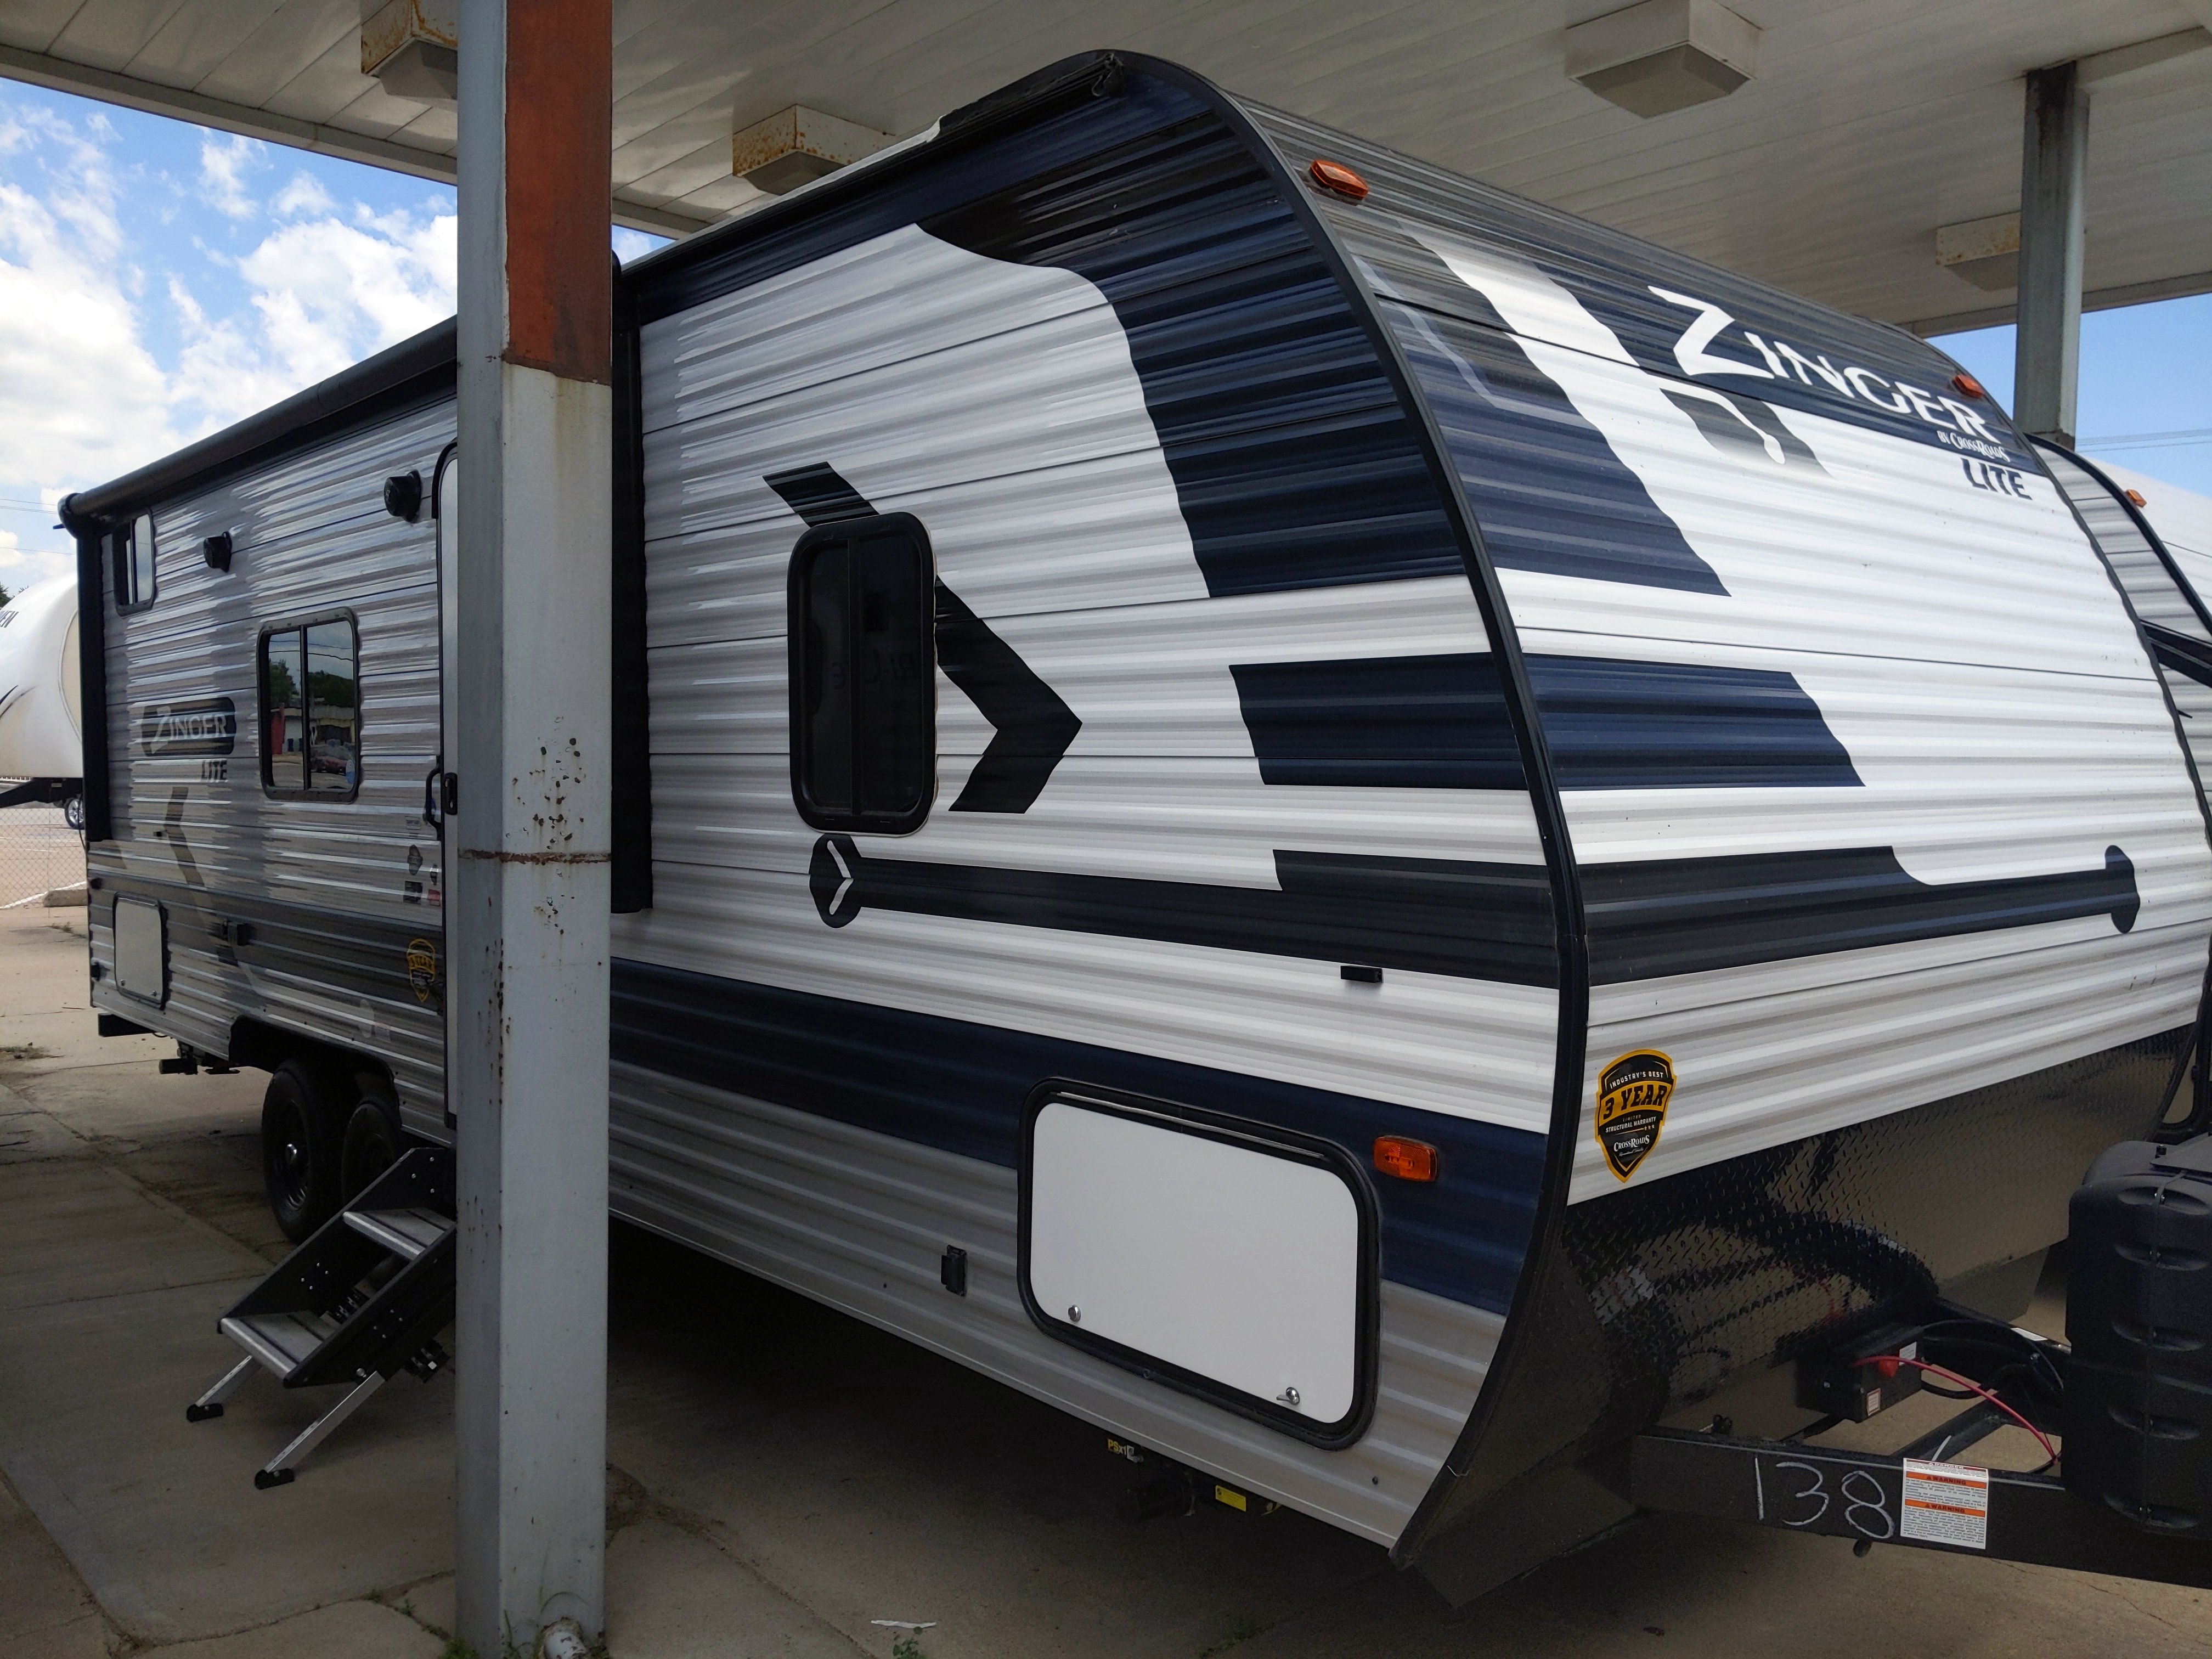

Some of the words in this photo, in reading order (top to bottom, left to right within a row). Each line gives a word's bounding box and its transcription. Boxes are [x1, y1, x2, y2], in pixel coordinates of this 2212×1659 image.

[1647, 285, 2001, 444] ZINGER
[1937, 430, 1951, 444] BY
[1960, 458, 2033, 500] LITE
[150, 706, 227, 754] ZINGER
[201, 759, 228, 782] LITE
[1610, 1071, 1646, 1089] INDUSTRY'S
[1603, 1097, 1615, 1120] 3
[1621, 1084, 1668, 1111] YEAR
[1605, 1122, 1633, 1133] STRUCTURAL
[1634, 1116, 1657, 1126] WARRANTY
[1932, 1476, 1966, 1485] WARNING
[1755, 1457, 1896, 1539] 138
[1932, 1504, 1966, 1513] WARNING
